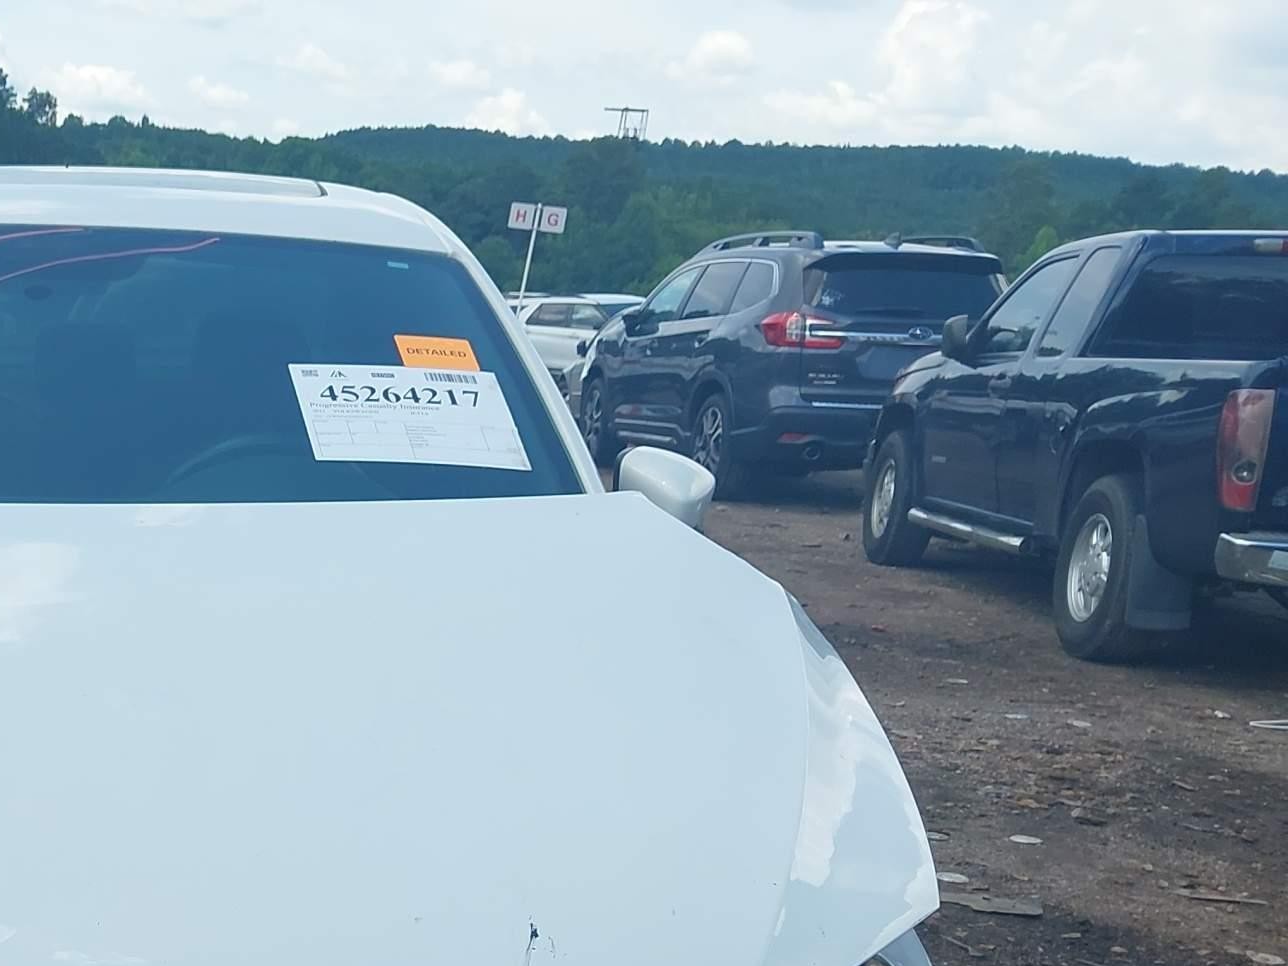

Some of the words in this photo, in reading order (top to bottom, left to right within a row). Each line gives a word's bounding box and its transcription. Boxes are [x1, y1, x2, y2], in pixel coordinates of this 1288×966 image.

[515, 209, 527, 223] H
[547, 212, 560, 227] G
[406, 347, 467, 358] DETAILED
[319, 384, 479, 408] 45264217
